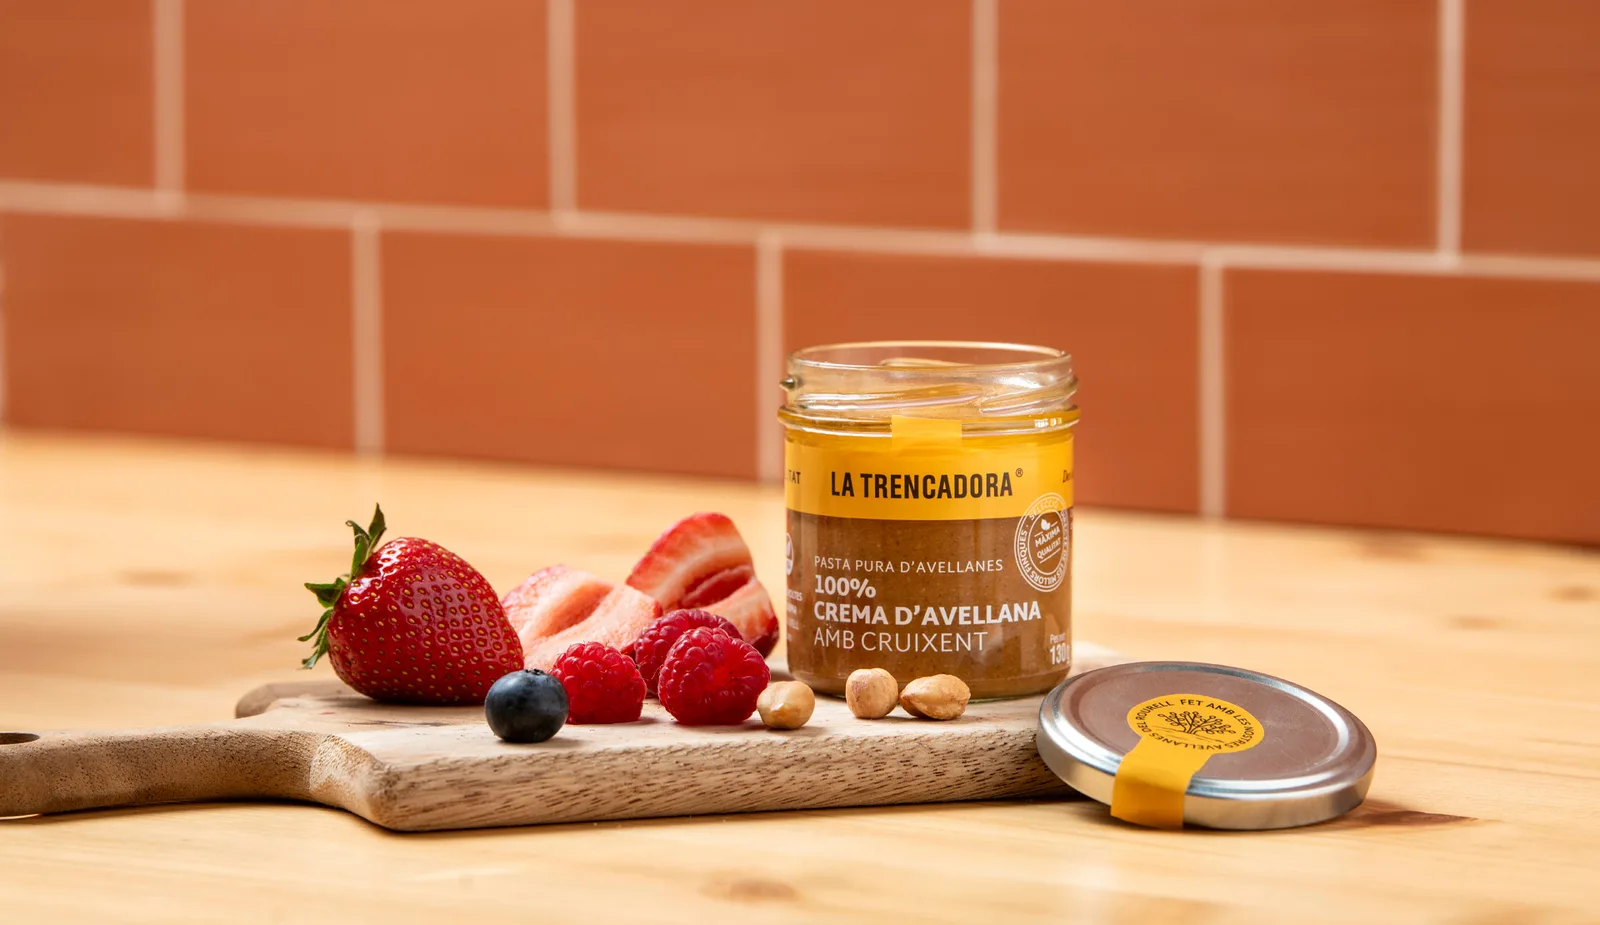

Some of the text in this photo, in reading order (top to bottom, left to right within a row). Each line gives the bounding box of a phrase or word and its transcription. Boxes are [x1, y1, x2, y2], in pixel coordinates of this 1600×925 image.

[831, 471, 854, 497] LA
[860, 472, 1013, 499] TRENCADORA
[1019, 530, 1032, 573] FINQUES
[1036, 537, 1061, 559] QUALITAT
[814, 556, 851, 571] PASTA
[855, 560, 895, 573] PURA
[814, 574, 877, 599] 100%
[813, 601, 889, 625] CREMA
[813, 627, 855, 650] AMB
[861, 631, 988, 652] CRUIXENT
[1135, 698, 1255, 751] FET AMB LES NOSTRES AVELLANES DEL ROURELL
